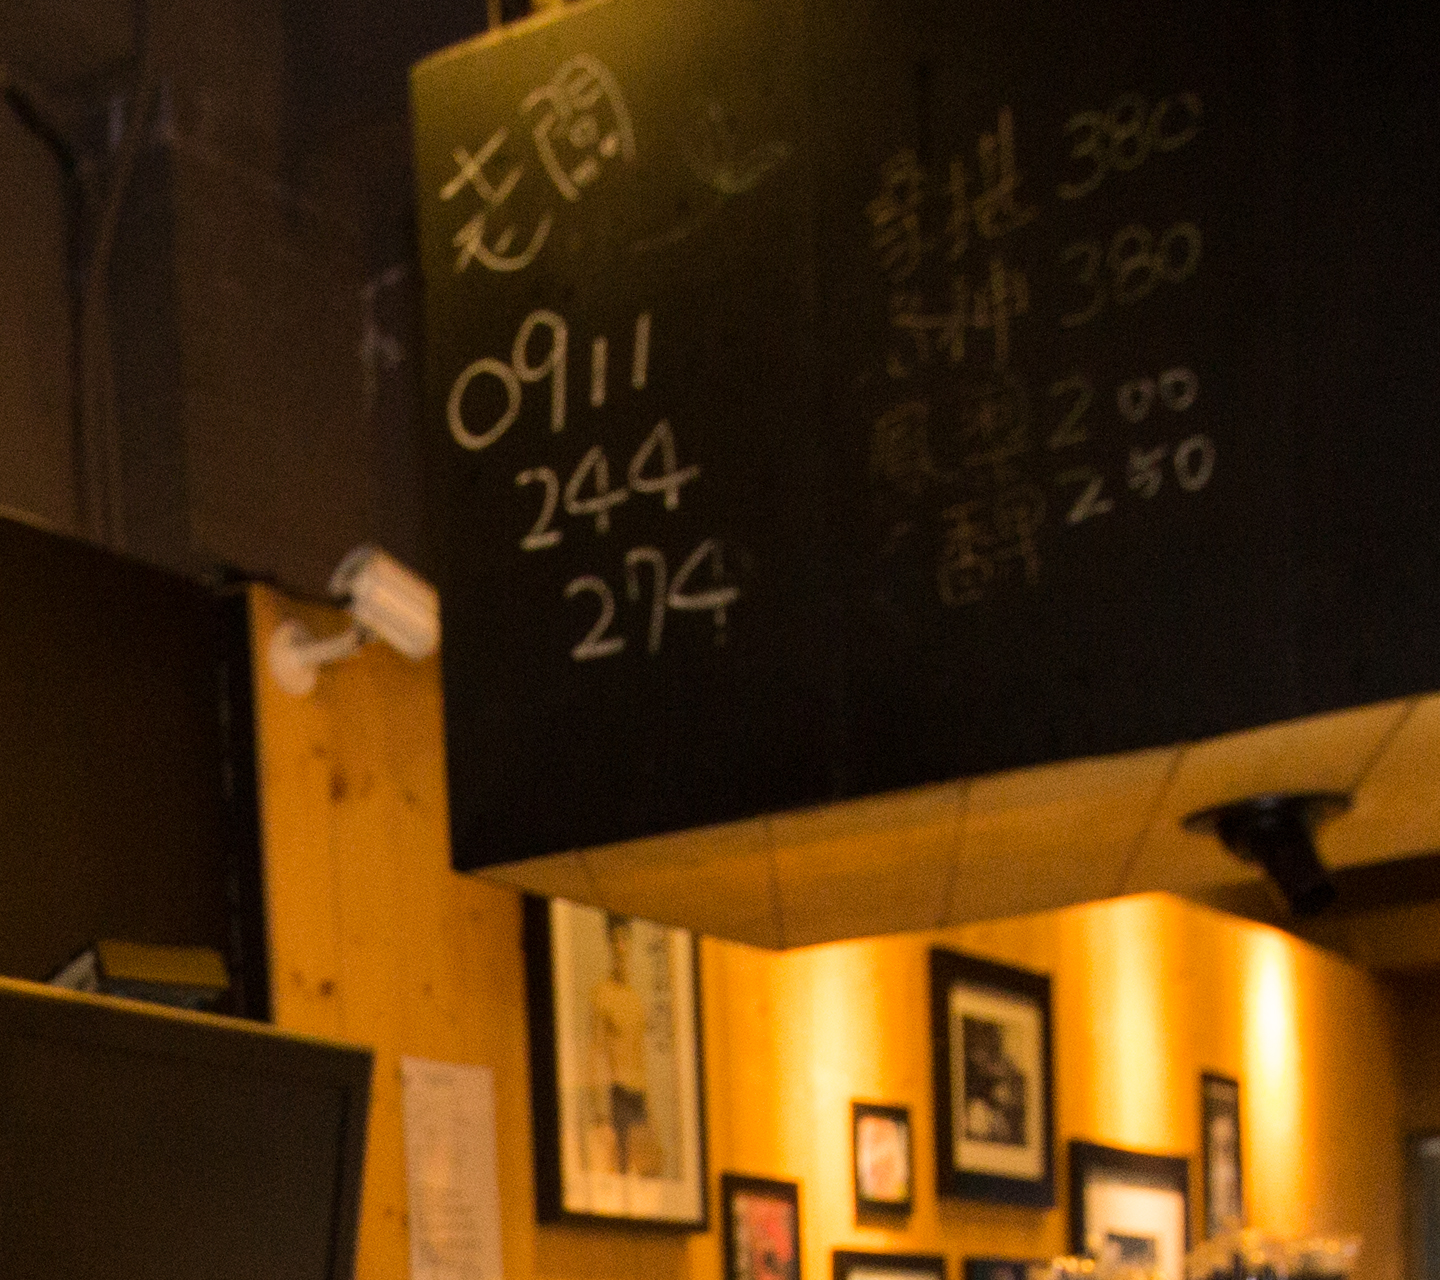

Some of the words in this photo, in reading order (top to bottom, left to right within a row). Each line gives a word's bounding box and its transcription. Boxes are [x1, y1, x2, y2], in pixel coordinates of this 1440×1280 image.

[1057, 90, 1204, 202] 380
[1057, 221, 1204, 329] 380
[446, 309, 654, 452] 0911
[514, 417, 701, 553] 244
[563, 539, 741, 662] 274
